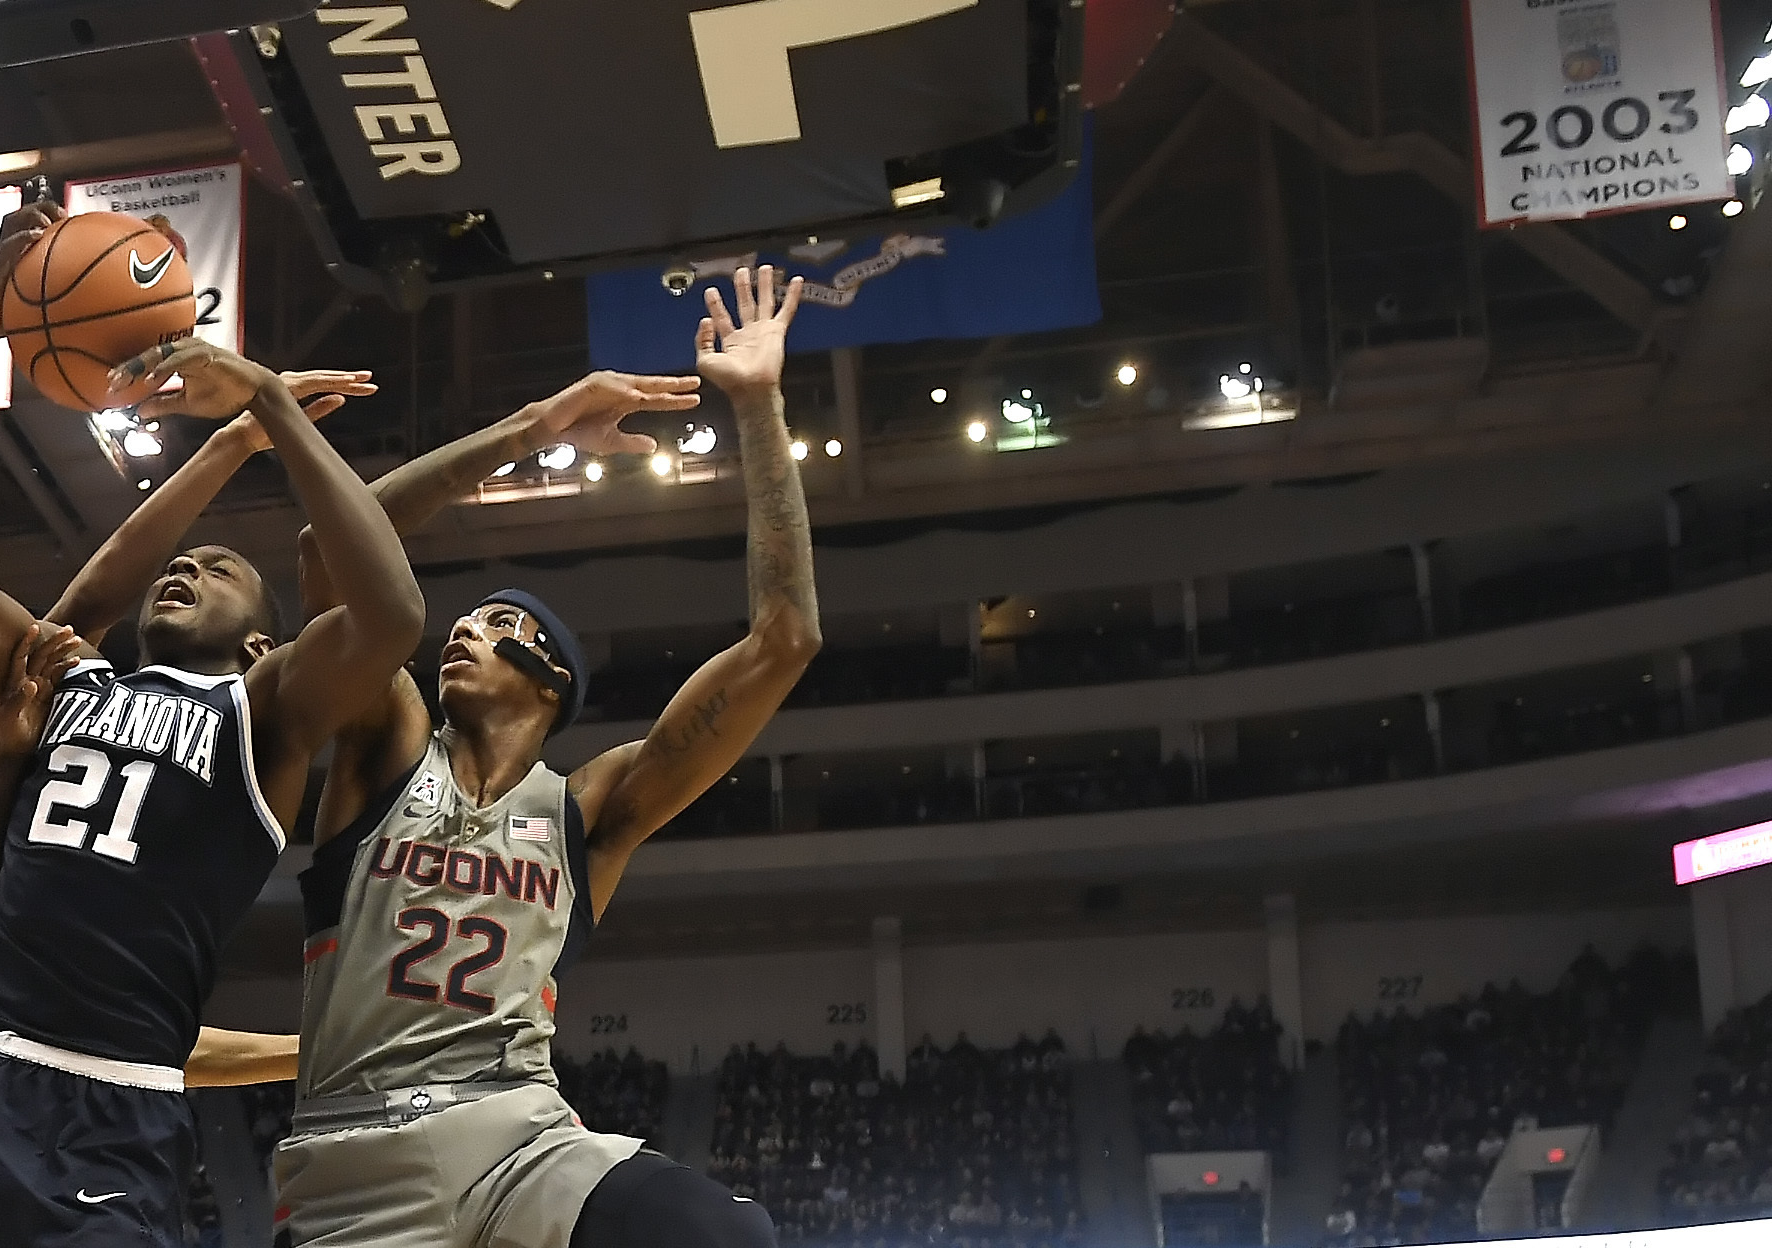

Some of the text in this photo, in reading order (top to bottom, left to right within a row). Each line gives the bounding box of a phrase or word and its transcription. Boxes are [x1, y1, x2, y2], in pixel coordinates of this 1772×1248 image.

[315, 0, 462, 180] NTER
[1498, 88, 1700, 157] 2003
[85, 183, 142, 198] UConn
[1521, 147, 1683, 182] NATIONAL
[111, 190, 201, 212] Basketball
[1509, 172, 1701, 212] CHAMPIONS
[28, 744, 158, 865] 21
[371, 837, 561, 911] UCONN
[386, 906, 508, 1015] 22
[828, 1003, 867, 1024] 225
